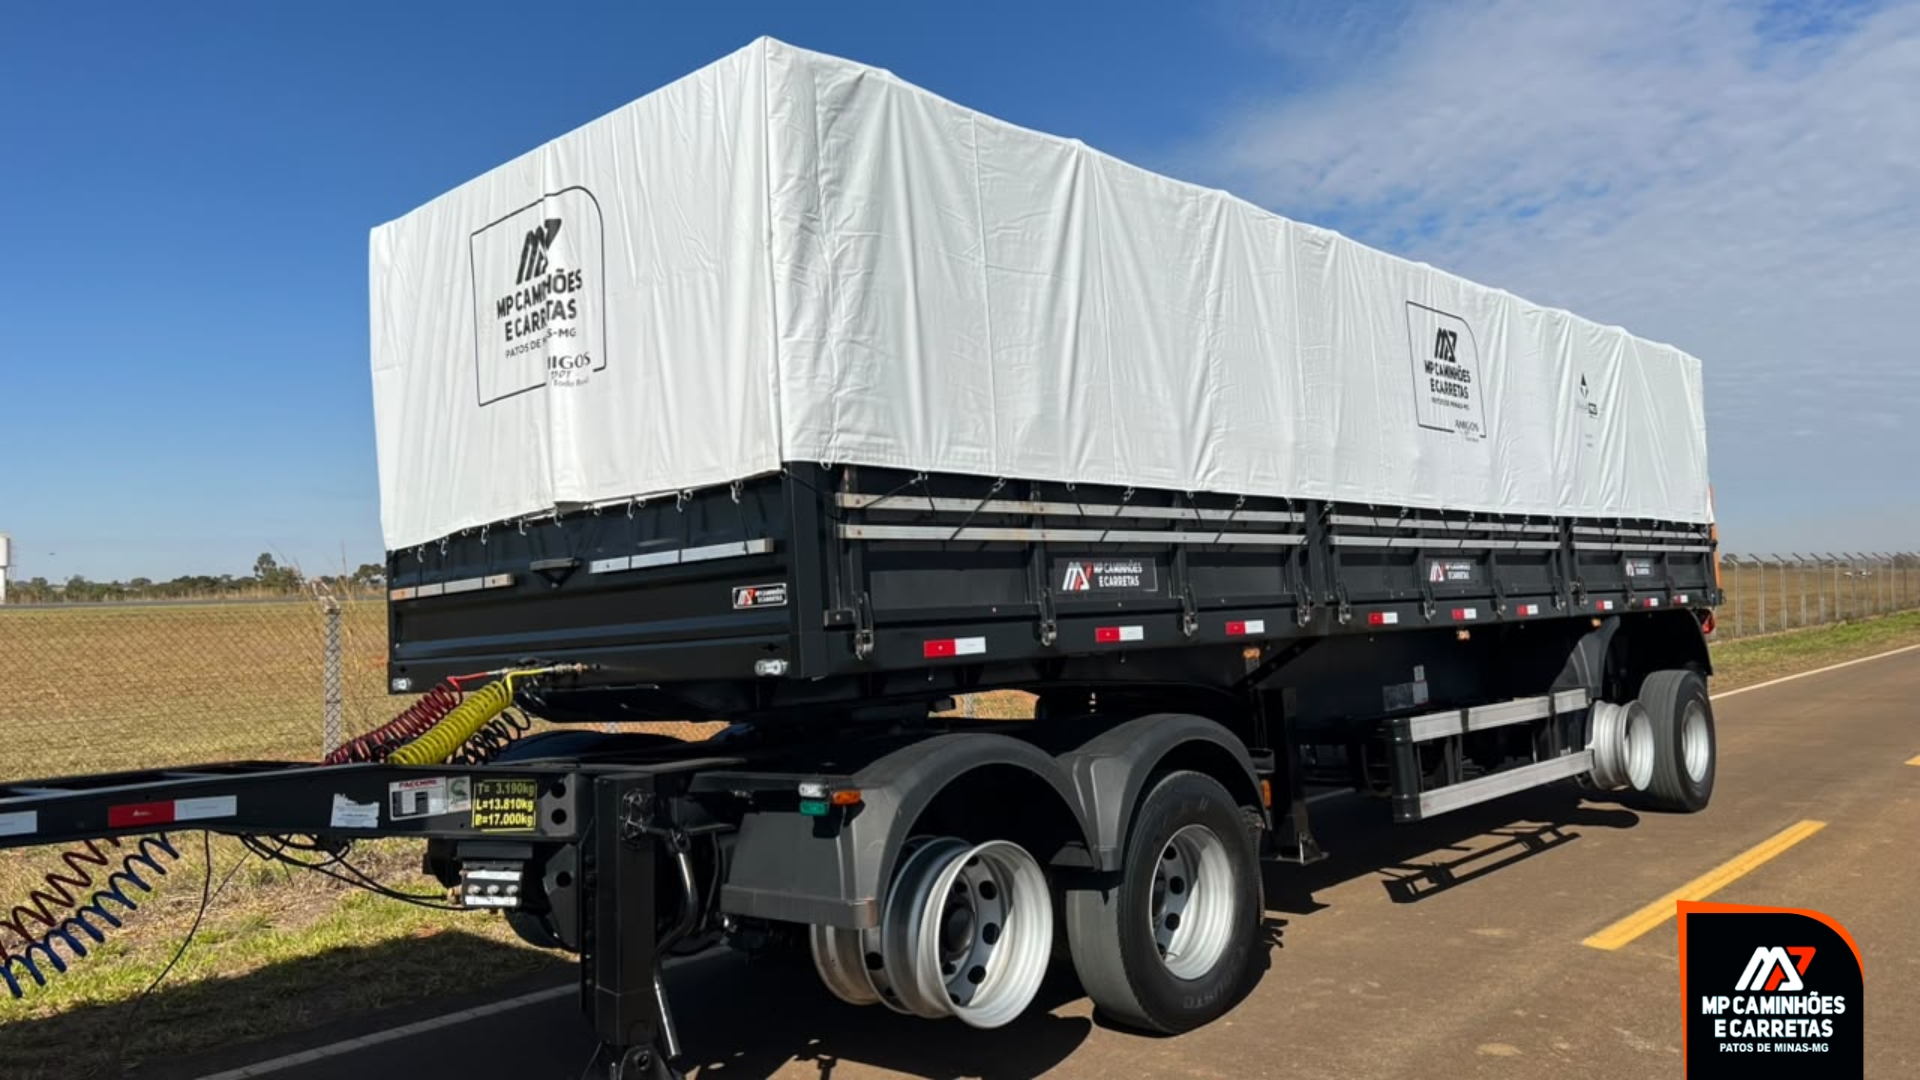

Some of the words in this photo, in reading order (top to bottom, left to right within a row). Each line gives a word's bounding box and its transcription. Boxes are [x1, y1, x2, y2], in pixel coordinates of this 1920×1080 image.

[496, 295, 513, 319] MP
[515, 268, 583, 311] CAMHÕES
[505, 320, 513, 342] E
[515, 298, 577, 338] CARRTAS
[505, 343, 529, 358] PATOS
[530, 339, 541, 350] DE
